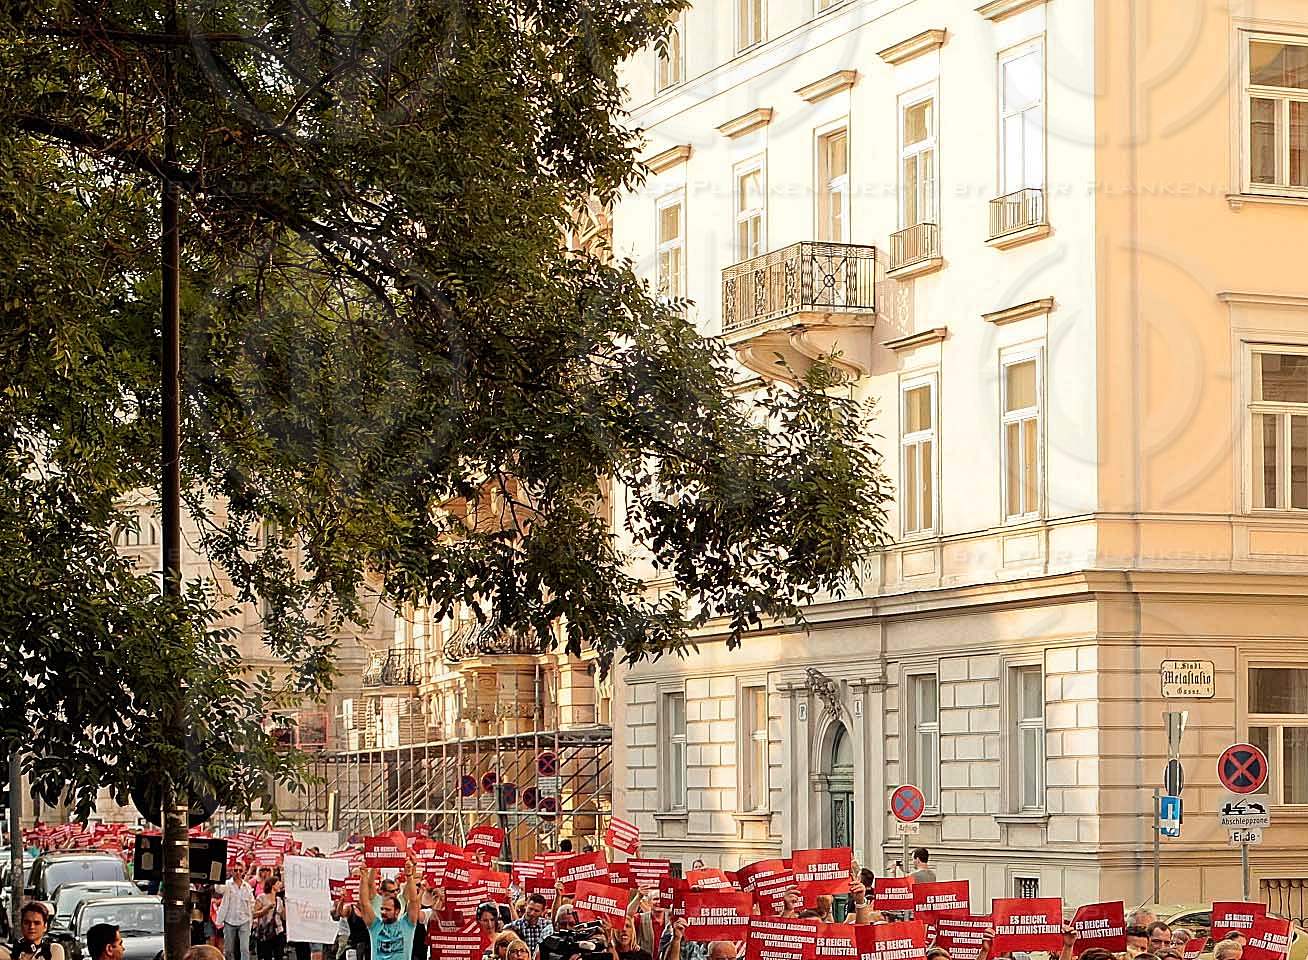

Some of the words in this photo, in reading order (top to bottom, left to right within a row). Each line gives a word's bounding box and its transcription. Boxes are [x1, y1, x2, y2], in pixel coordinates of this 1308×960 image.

[1221, 817, 1268, 825] Abschleppzone
[1010, 916, 1019, 924] ES
[817, 938, 825, 946] ES
[875, 941, 885, 951] ES
